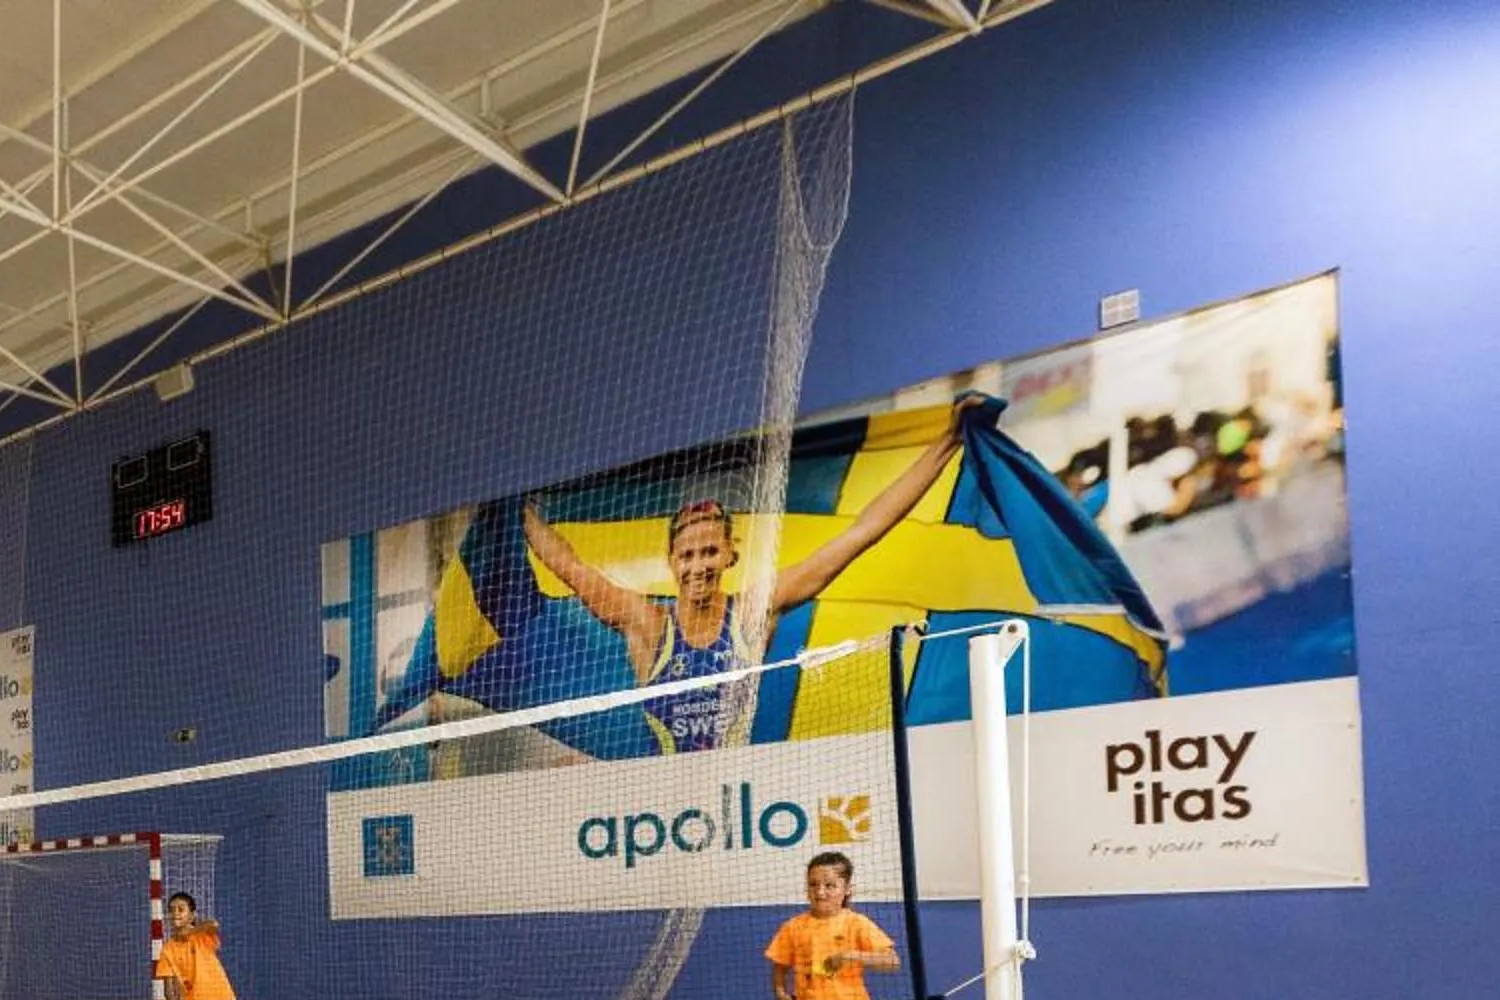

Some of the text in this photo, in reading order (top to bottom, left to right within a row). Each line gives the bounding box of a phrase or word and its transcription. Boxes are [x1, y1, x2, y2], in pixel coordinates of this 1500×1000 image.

[139, 502, 184, 538] 17:54
[1105, 729, 1257, 792] play
[1133, 781, 1252, 824] itas
[577, 781, 809, 869] apollo
[1088, 833, 1280, 858] Free your mind
